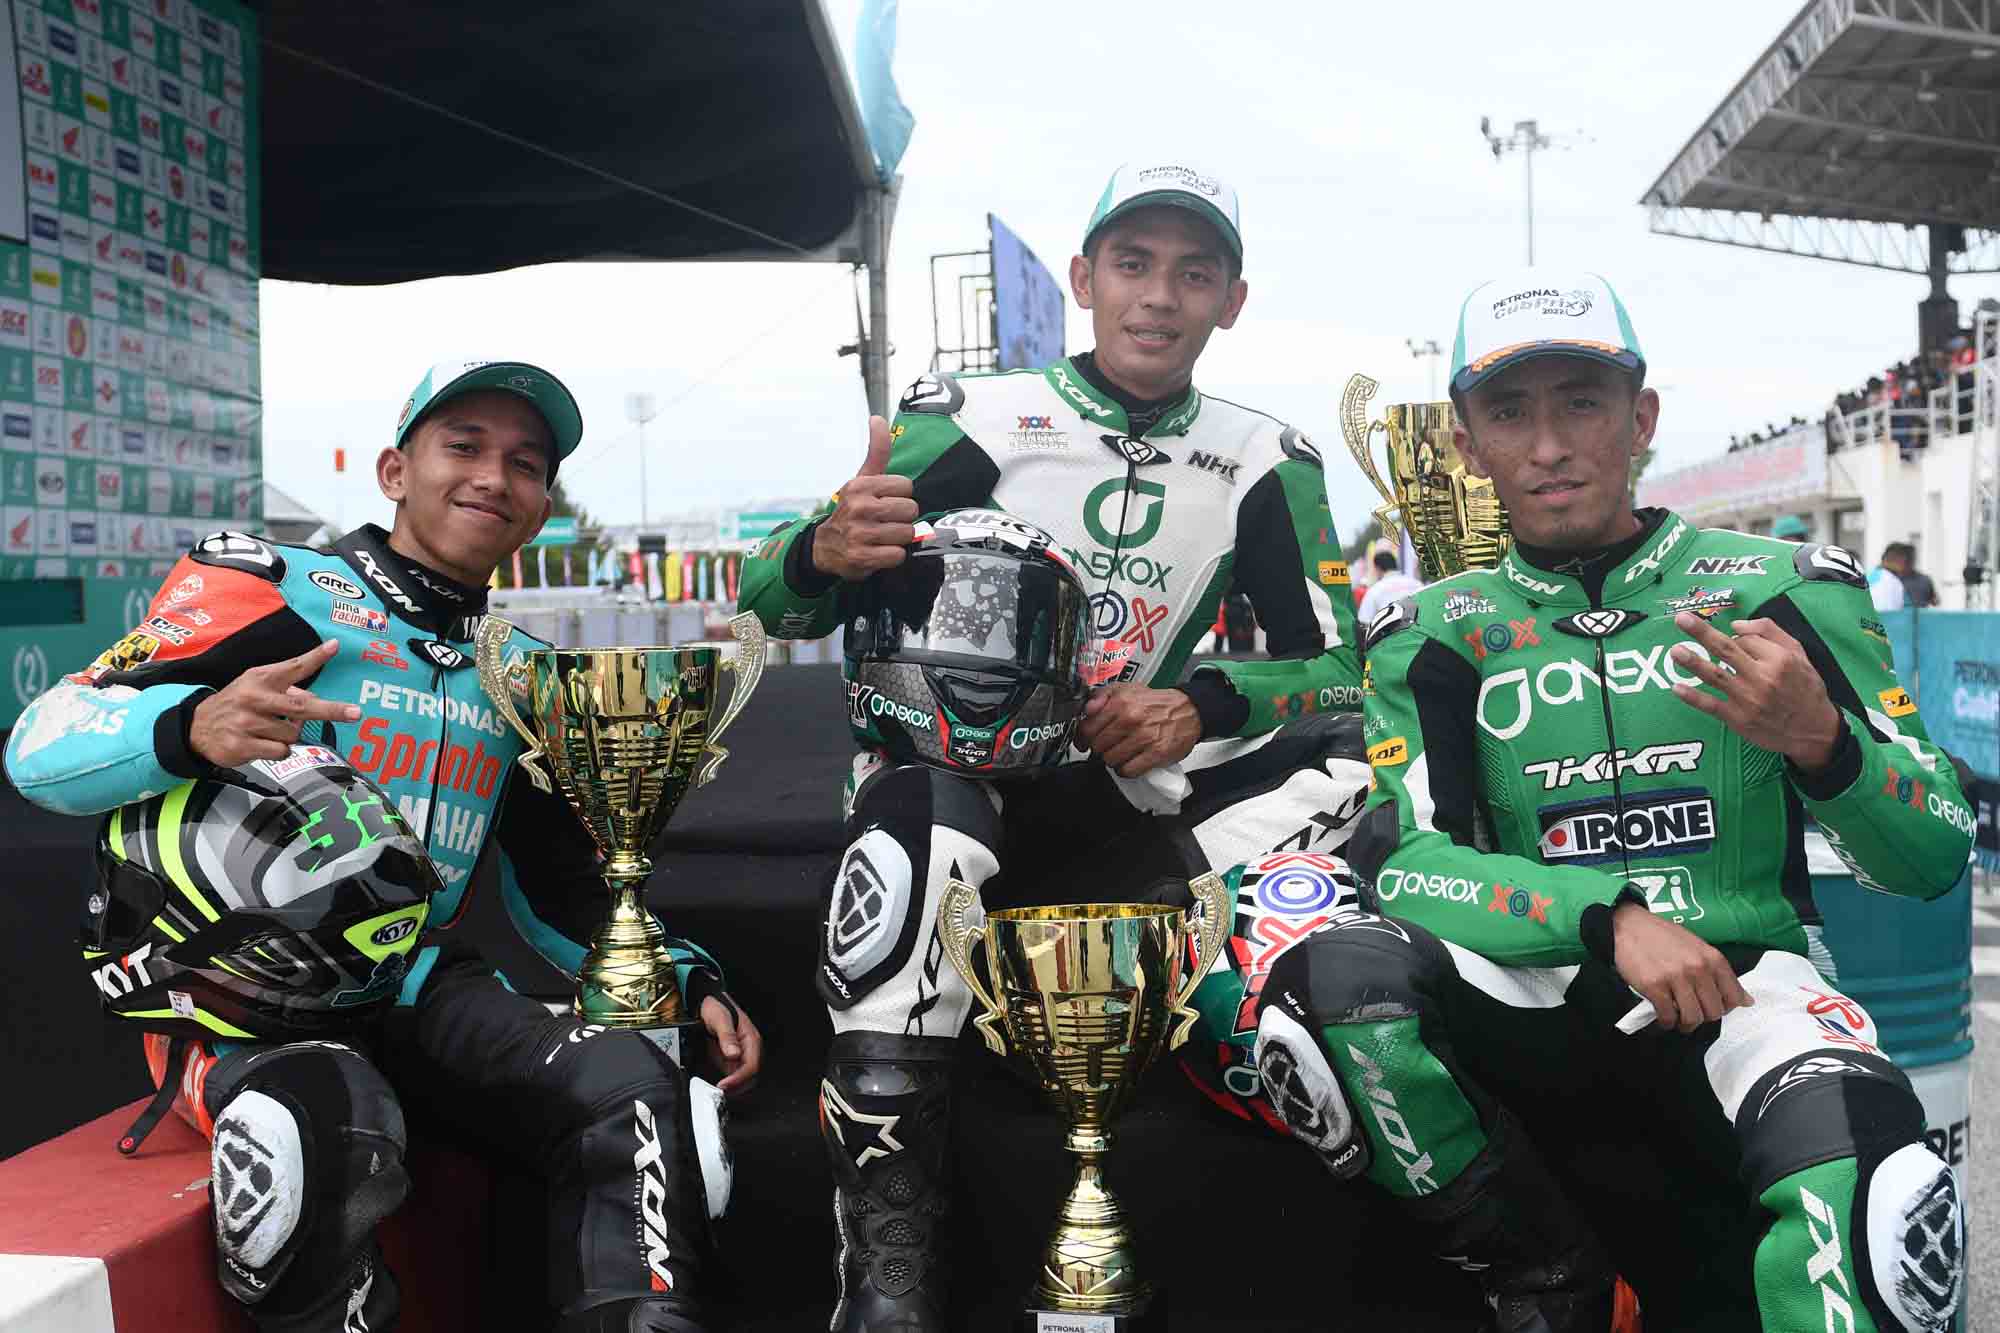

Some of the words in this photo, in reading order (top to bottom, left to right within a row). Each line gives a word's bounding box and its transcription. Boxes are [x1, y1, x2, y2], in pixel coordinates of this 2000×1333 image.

[1493, 289, 1560, 310] PETRONAS
[1185, 450, 1243, 486] NHK
[317, 575, 357, 595] ARC
[332, 612, 368, 627] racing
[335, 600, 360, 614] uma
[1086, 590, 1169, 653] OX
[1442, 604, 1498, 624] LEAGUE
[1535, 639, 1738, 705] ONEXO
[360, 680, 507, 738] PETRONAS
[350, 716, 502, 801] Sprinta
[1570, 800, 1716, 852] IPONE
[371, 918, 416, 945] KYT
[91, 942, 152, 999] KYT
